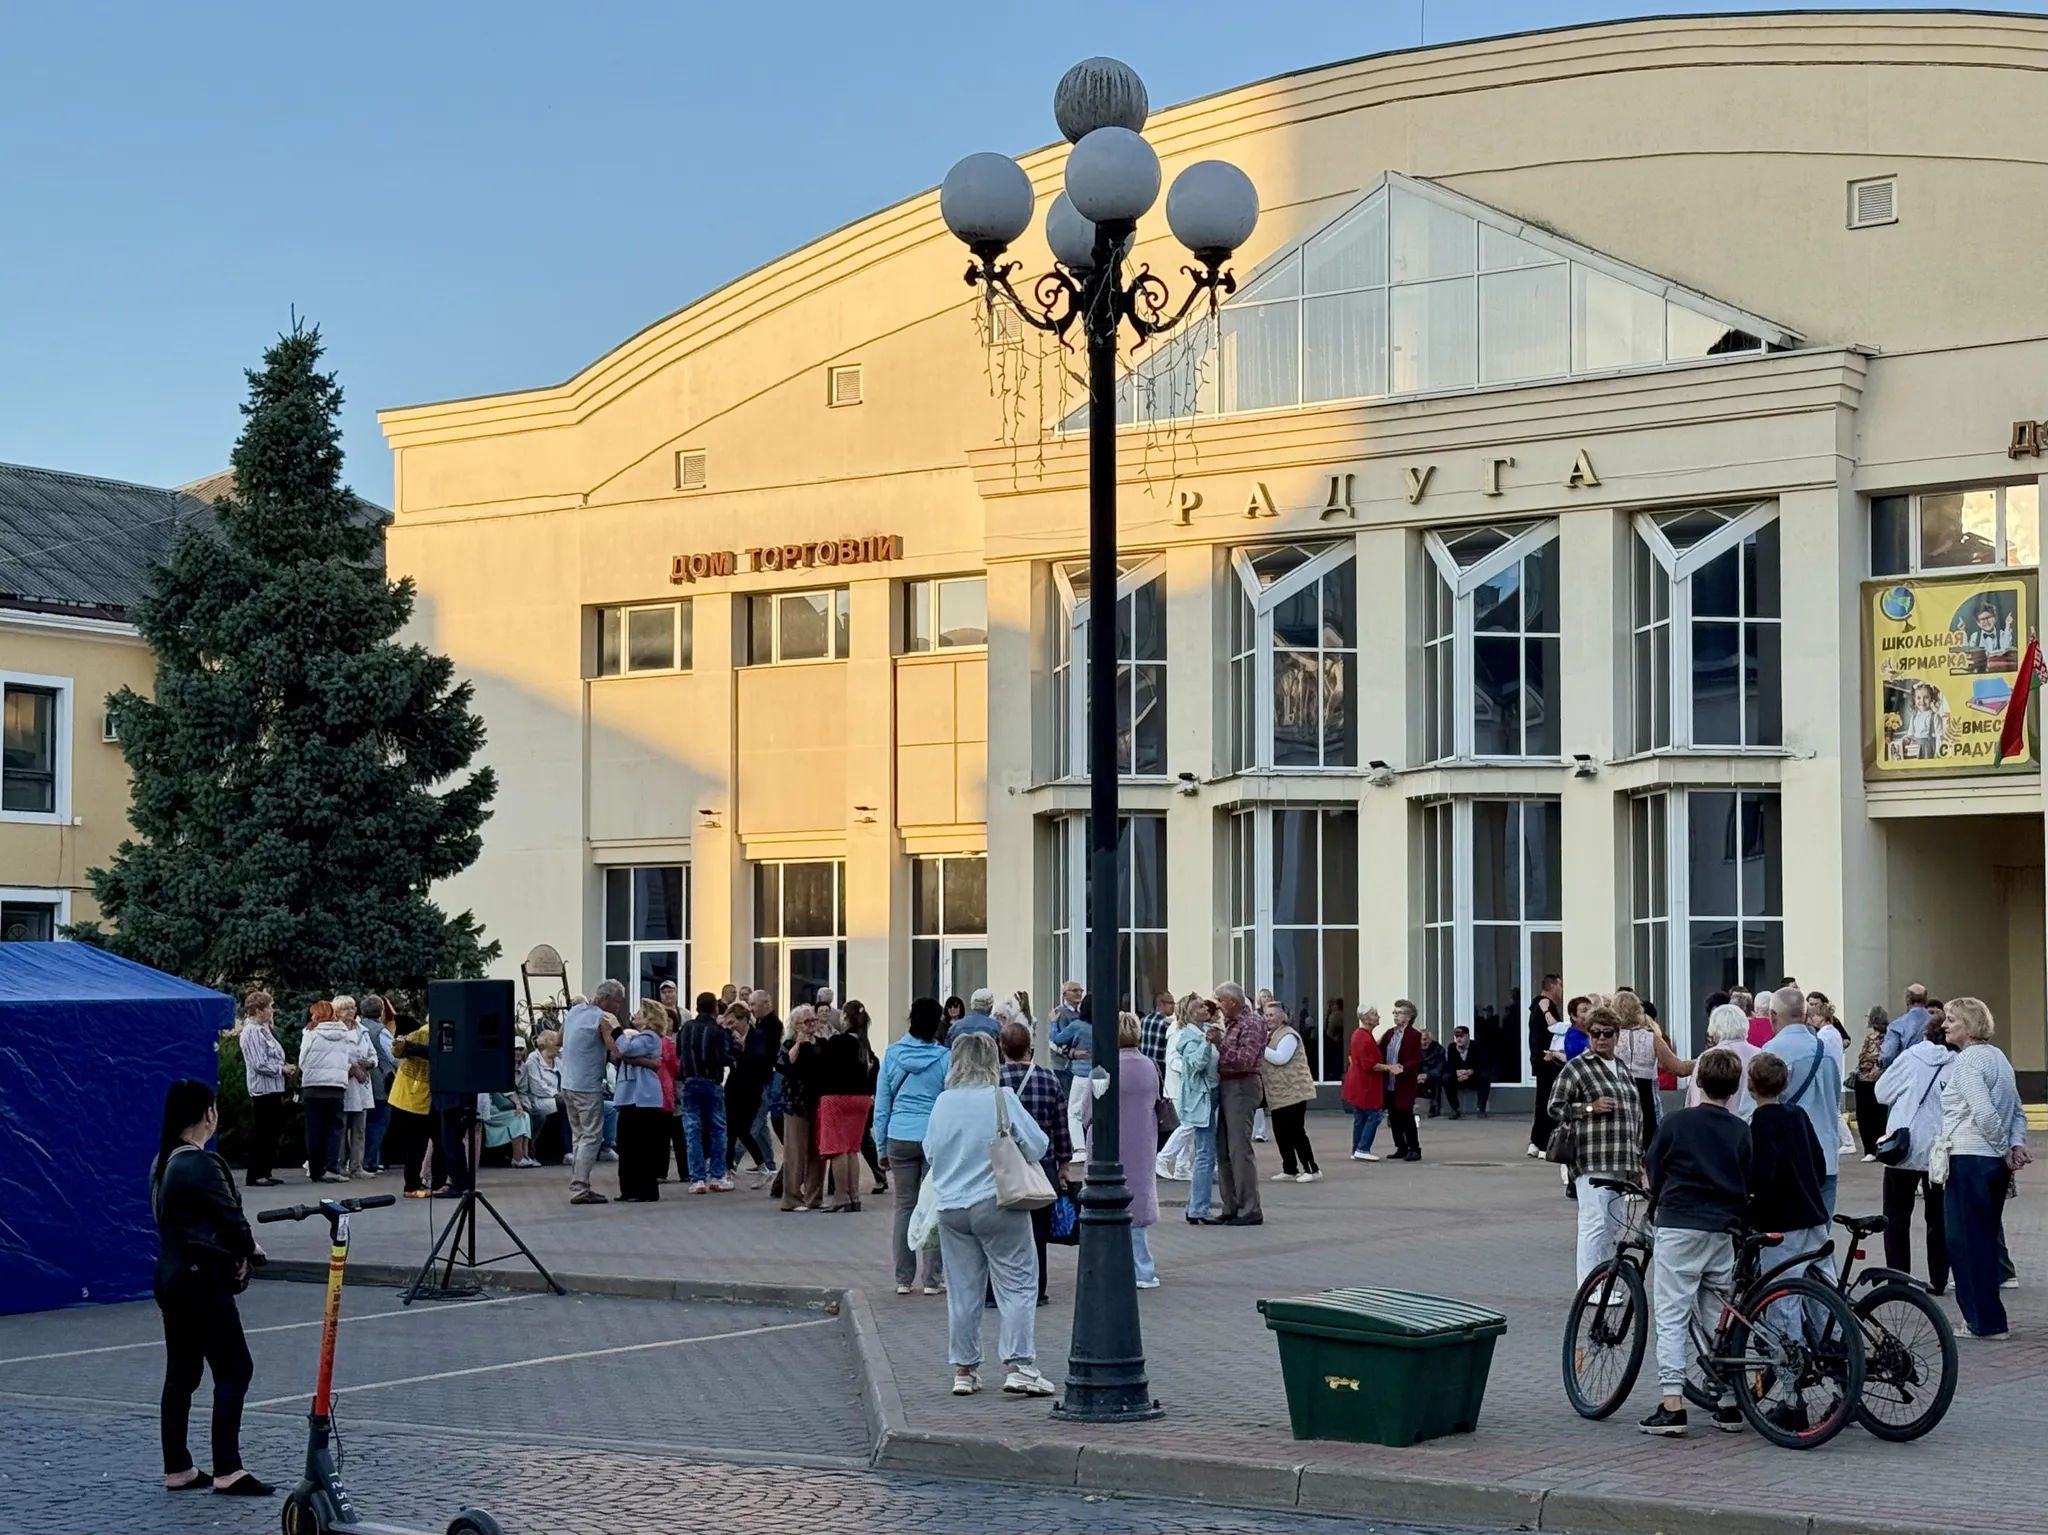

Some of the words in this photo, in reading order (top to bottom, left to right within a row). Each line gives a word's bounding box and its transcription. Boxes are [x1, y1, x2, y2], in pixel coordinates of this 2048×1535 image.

[2008, 420, 2048, 459] Д
[1171, 448, 1601, 527] РАДУГА
[670, 551, 736, 585] ДОМ
[745, 534, 904, 572] ТОРГОВЛИ
[1882, 631, 1964, 651] ШКОЛЬНАЯ
[1899, 653, 1967, 671] ЯРМАРКА
[1962, 719, 2004, 735] ВМЕС
[1939, 743, 1949, 757] С
[1954, 741, 1997, 758] РАДУ
